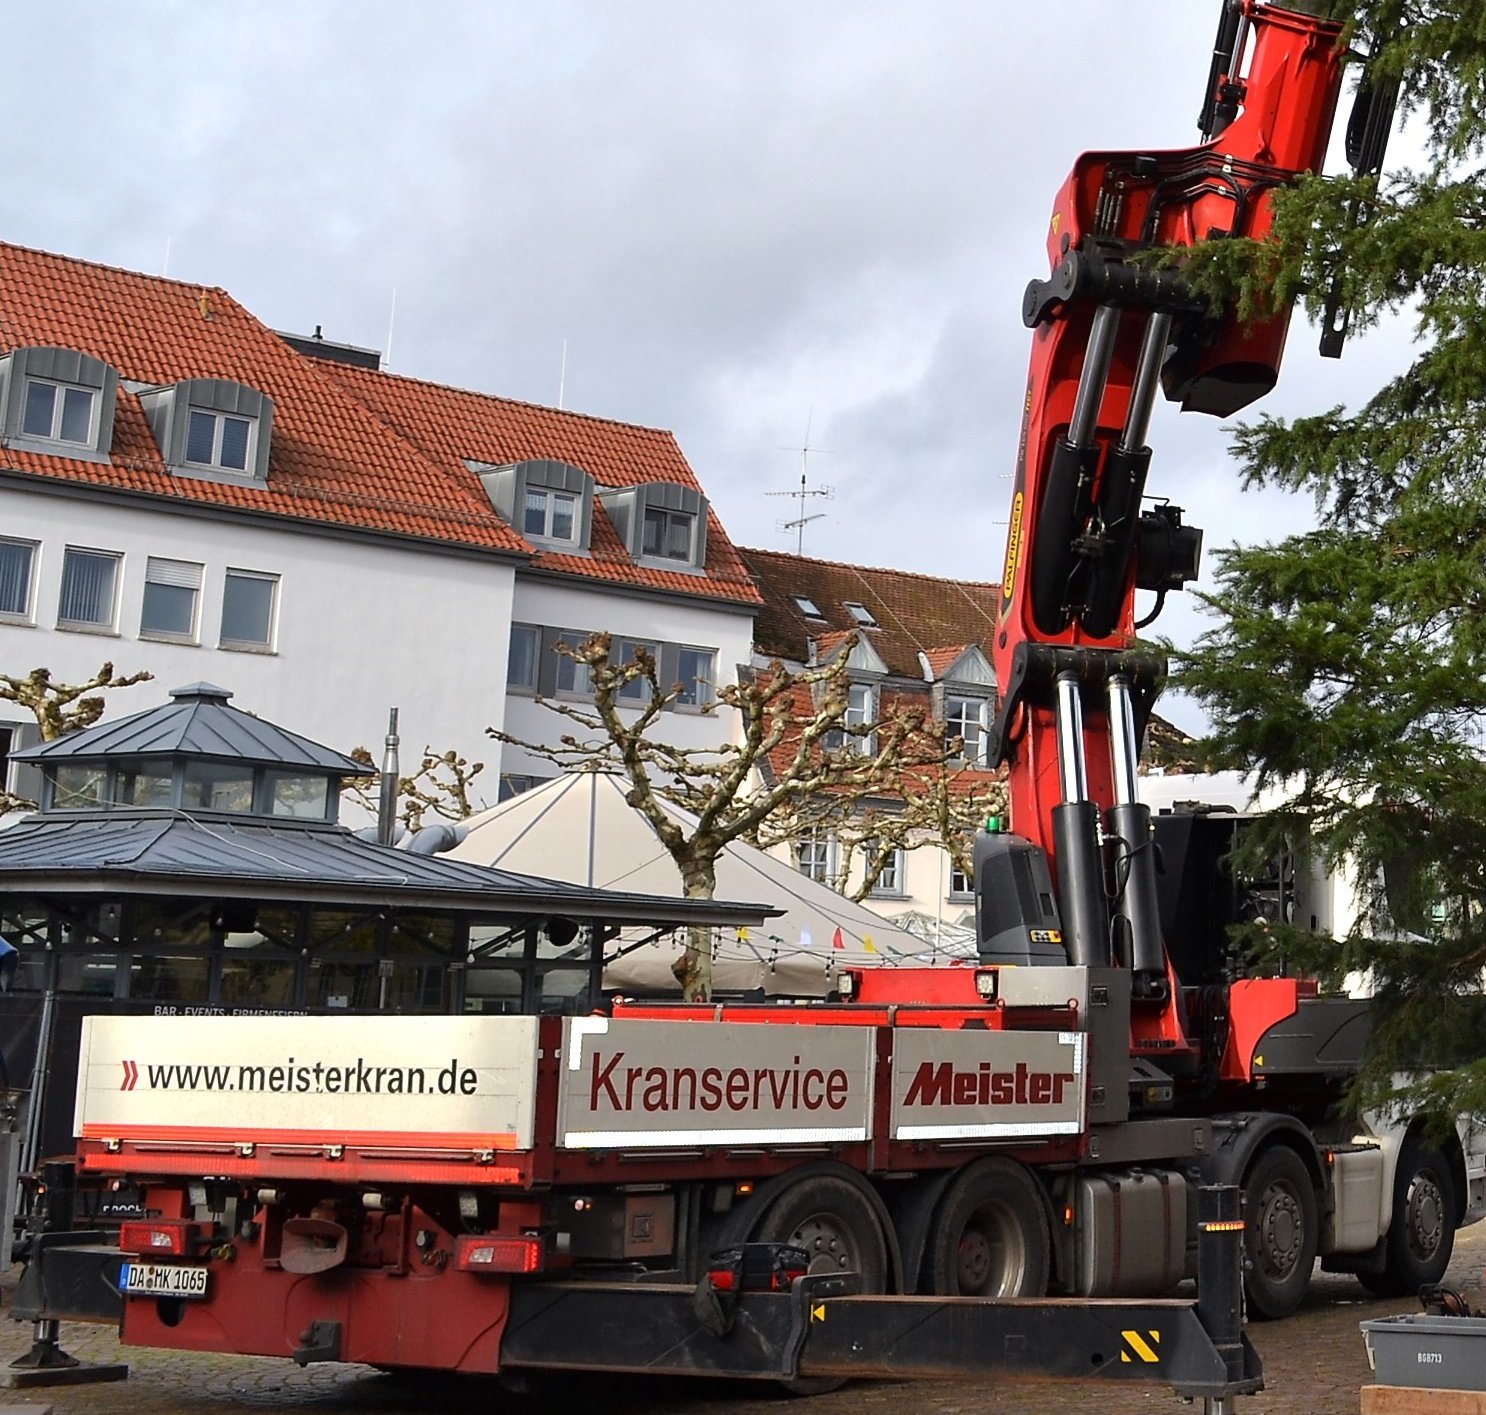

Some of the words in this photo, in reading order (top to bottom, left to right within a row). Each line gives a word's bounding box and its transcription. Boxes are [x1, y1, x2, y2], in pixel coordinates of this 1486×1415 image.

[1005, 499, 1021, 591] PALFINGER
[154, 1005, 177, 1016] BAR
[184, 1006, 225, 1016] EVENTS
[147, 1057, 478, 1095] www.meisterkran.de
[590, 1052, 848, 1112] Kranservice
[903, 1062, 1075, 1107] Meister
[128, 1267, 144, 1287] DA
[154, 1269, 171, 1289] MK
[174, 1270, 205, 1291] 1065
